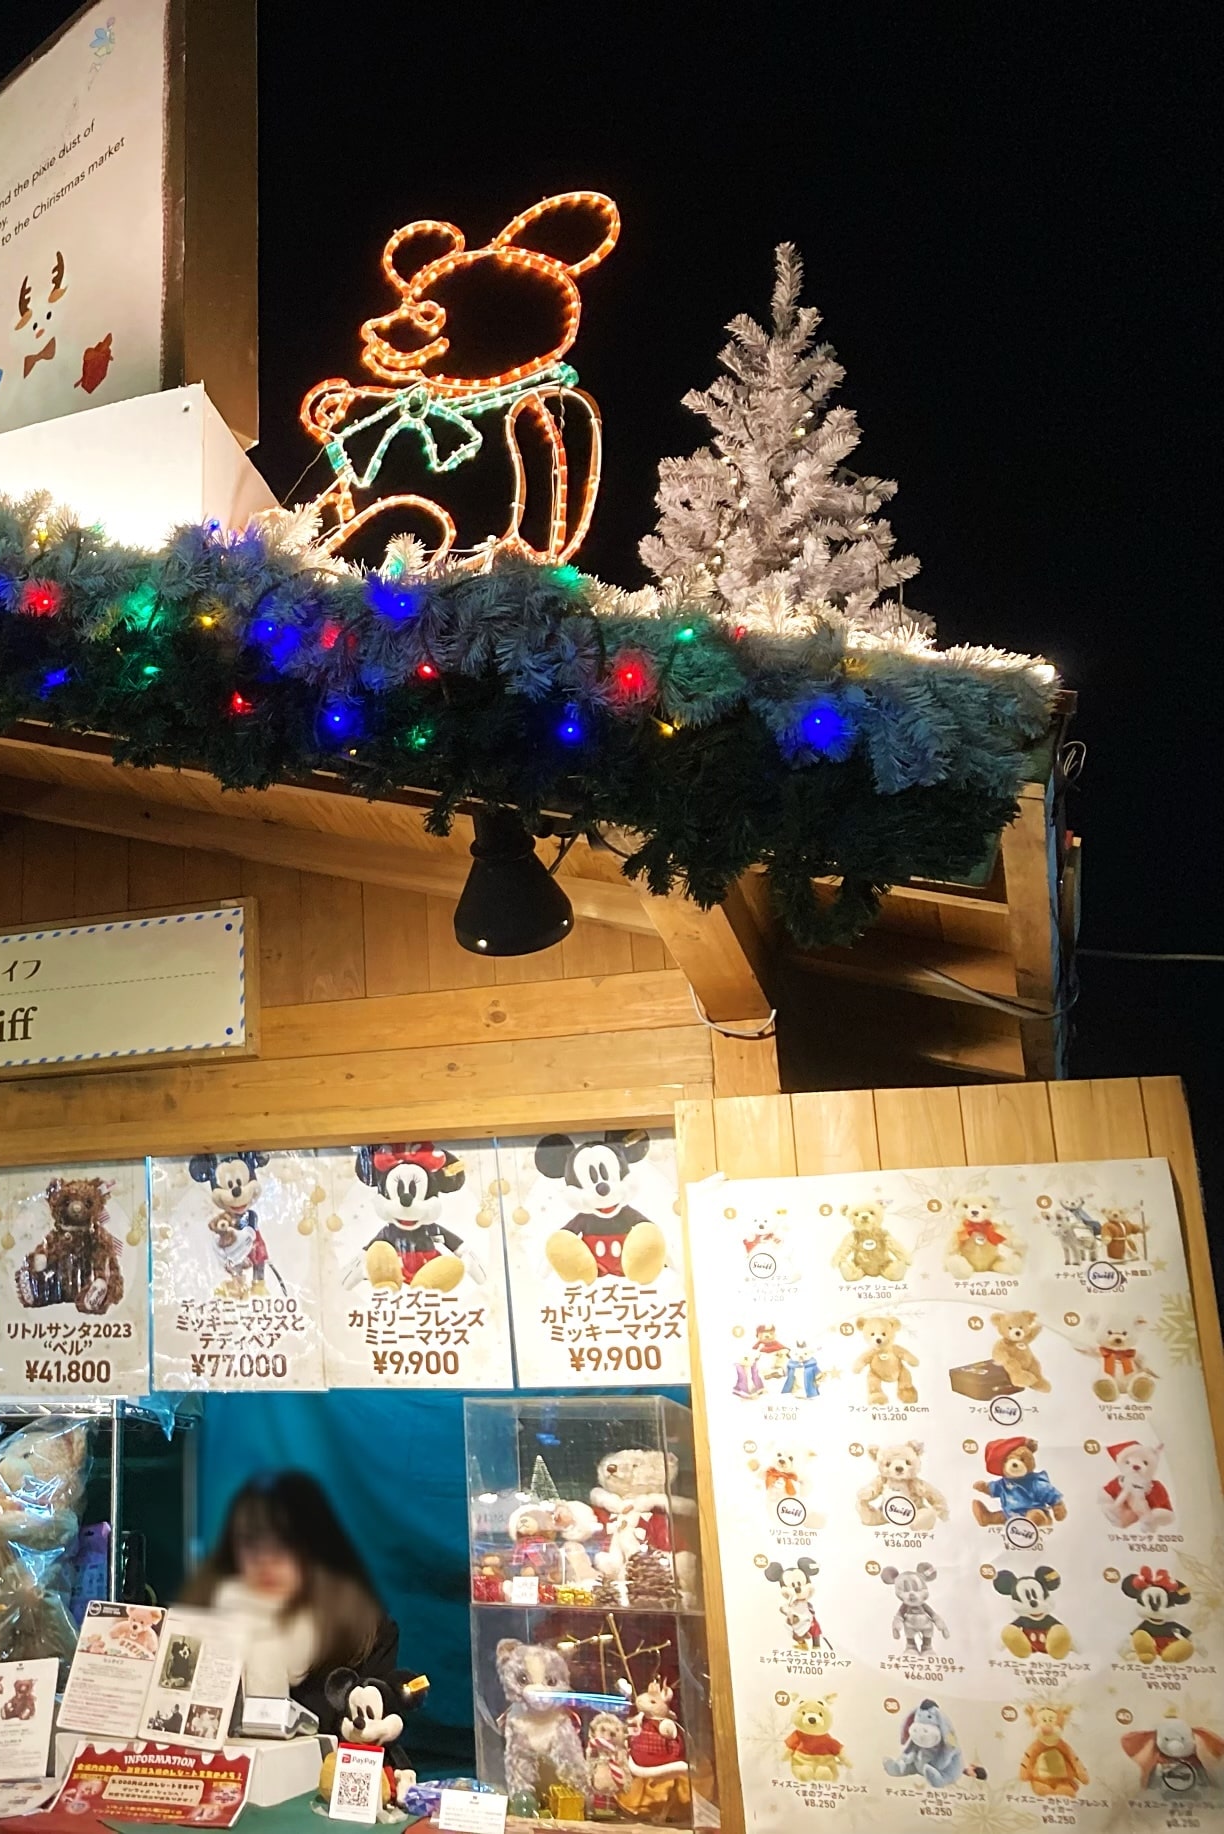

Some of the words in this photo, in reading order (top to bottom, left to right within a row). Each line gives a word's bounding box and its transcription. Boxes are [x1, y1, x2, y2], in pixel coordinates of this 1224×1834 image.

[13, 179, 30, 198] the
[32, 157, 56, 184] pixie
[58, 135, 82, 159] dust
[83, 119, 95, 137] of
[1, 233, 11, 247] to
[14, 218, 30, 235] the
[88, 137, 125, 175] market
[372, 1292, 457, 1309] ディズニー
[563, 1286, 657, 1303] ディズニー
[181, 1300, 296, 1314] ディズニーD100
[540, 1302, 686, 1325] カドリーフレンズ
[176, 1315, 305, 1333] ミッキーマウスと
[347, 1309, 484, 1328] カドリーフレンズ
[6, 1323, 132, 1339] リトルサンタ2023
[365, 1328, 469, 1346] ミニーマウス
[550, 1322, 681, 1341] ミッキーマウス
[199, 1333, 282, 1350] テディベア
[191, 1354, 287, 1378] ¥77,000
[373, 1350, 458, 1375] ¥9,900
[569, 1345, 661, 1372] ¥9,900
[25, 1360, 111, 1383] ¥41,800
[124, 1755, 196, 1768] INFORMATION
[352, 1756, 377, 1766] PayPay
